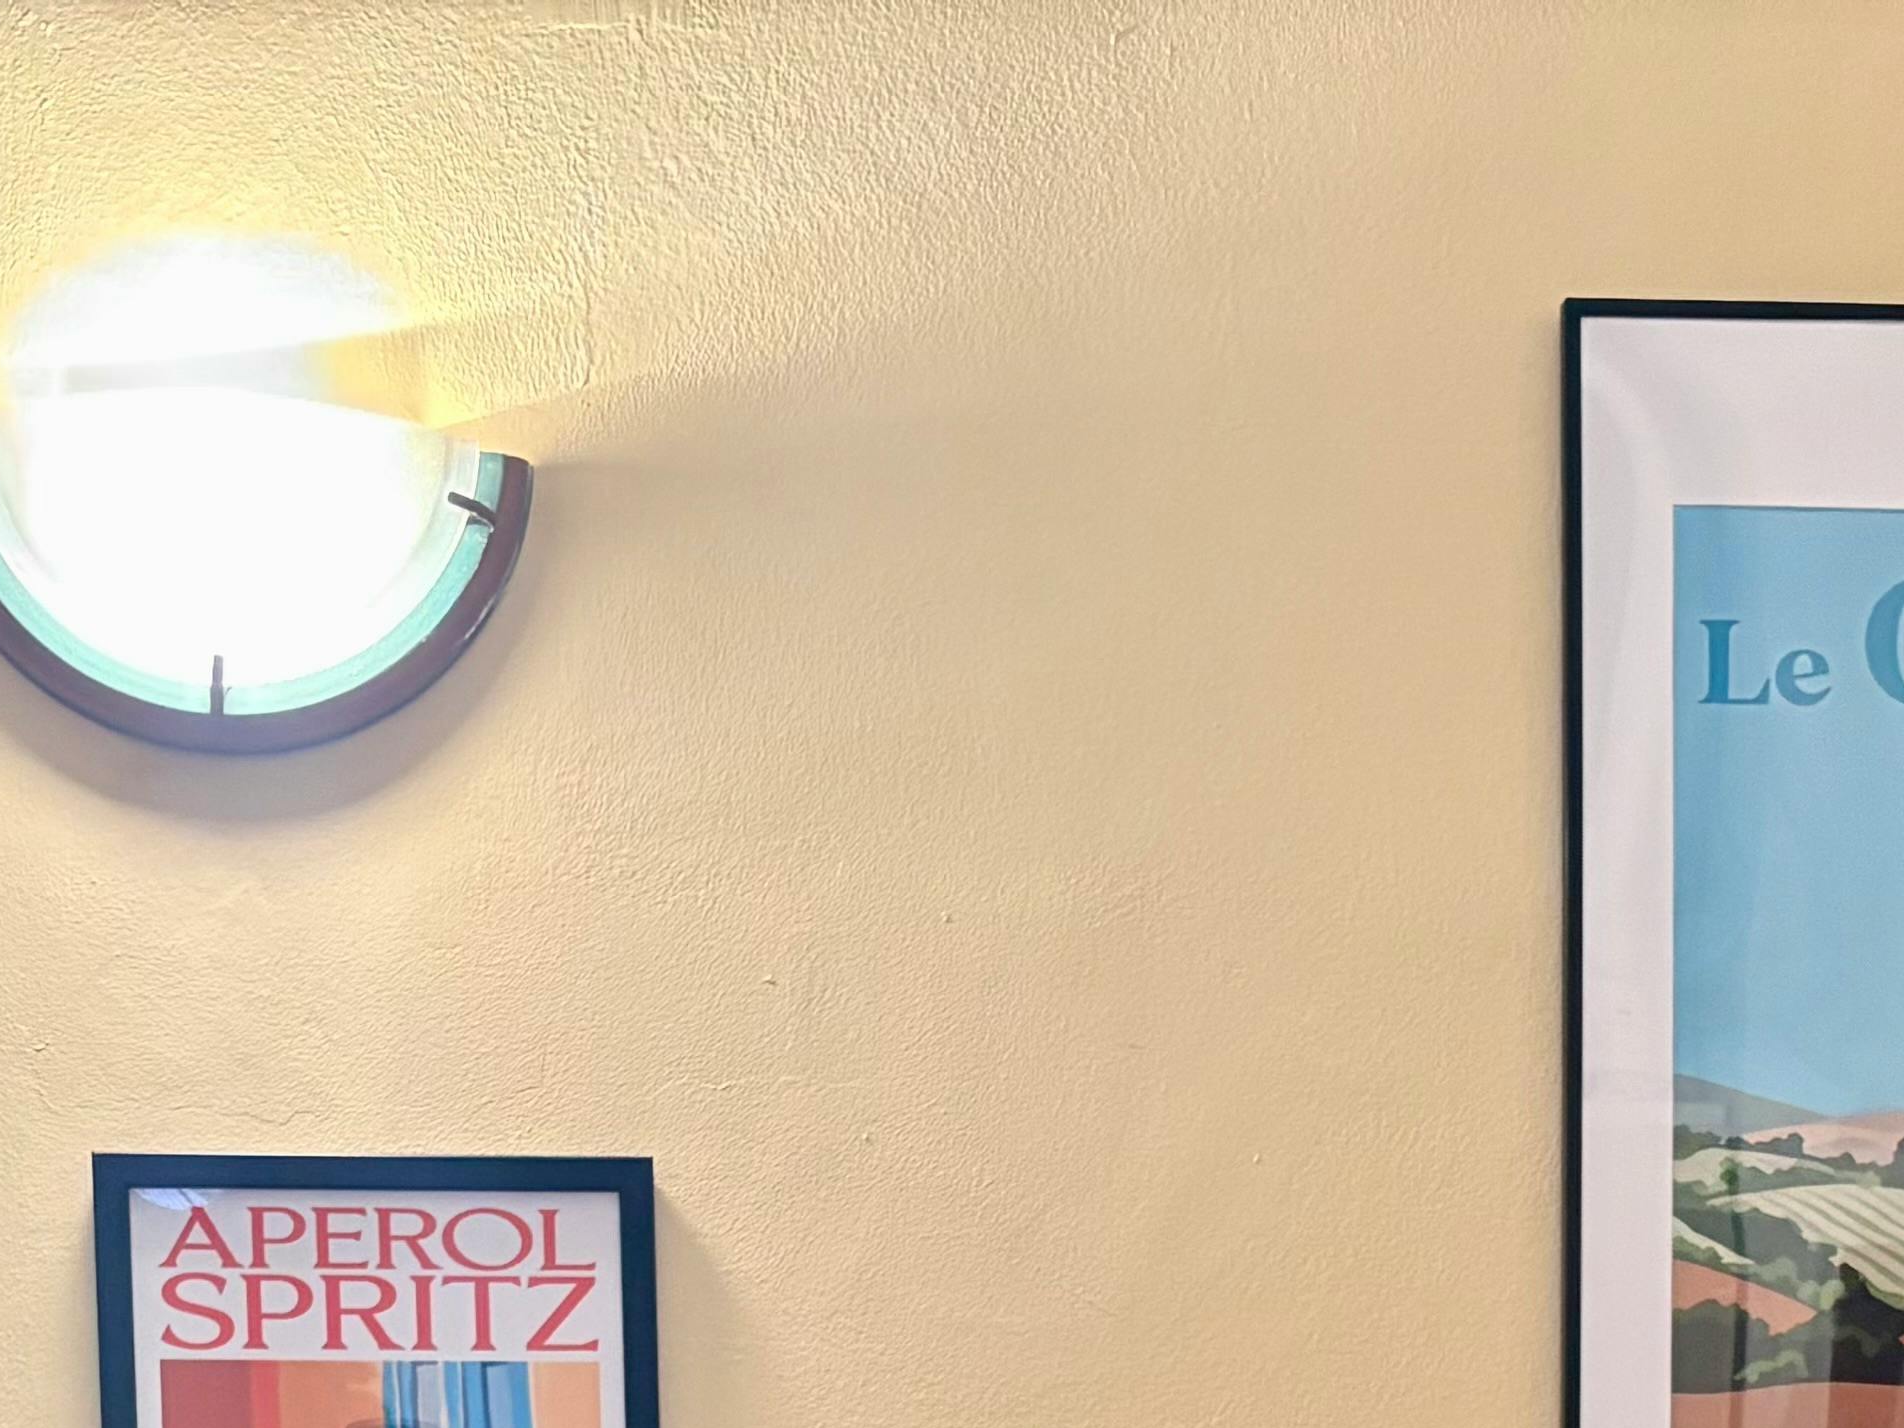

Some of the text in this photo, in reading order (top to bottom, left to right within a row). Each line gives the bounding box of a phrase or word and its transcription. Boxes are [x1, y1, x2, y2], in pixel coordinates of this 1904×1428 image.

[1698, 618, 1833, 707] Le
[158, 1205, 597, 1272] APEROL
[158, 1273, 600, 1352] SPRITZ
